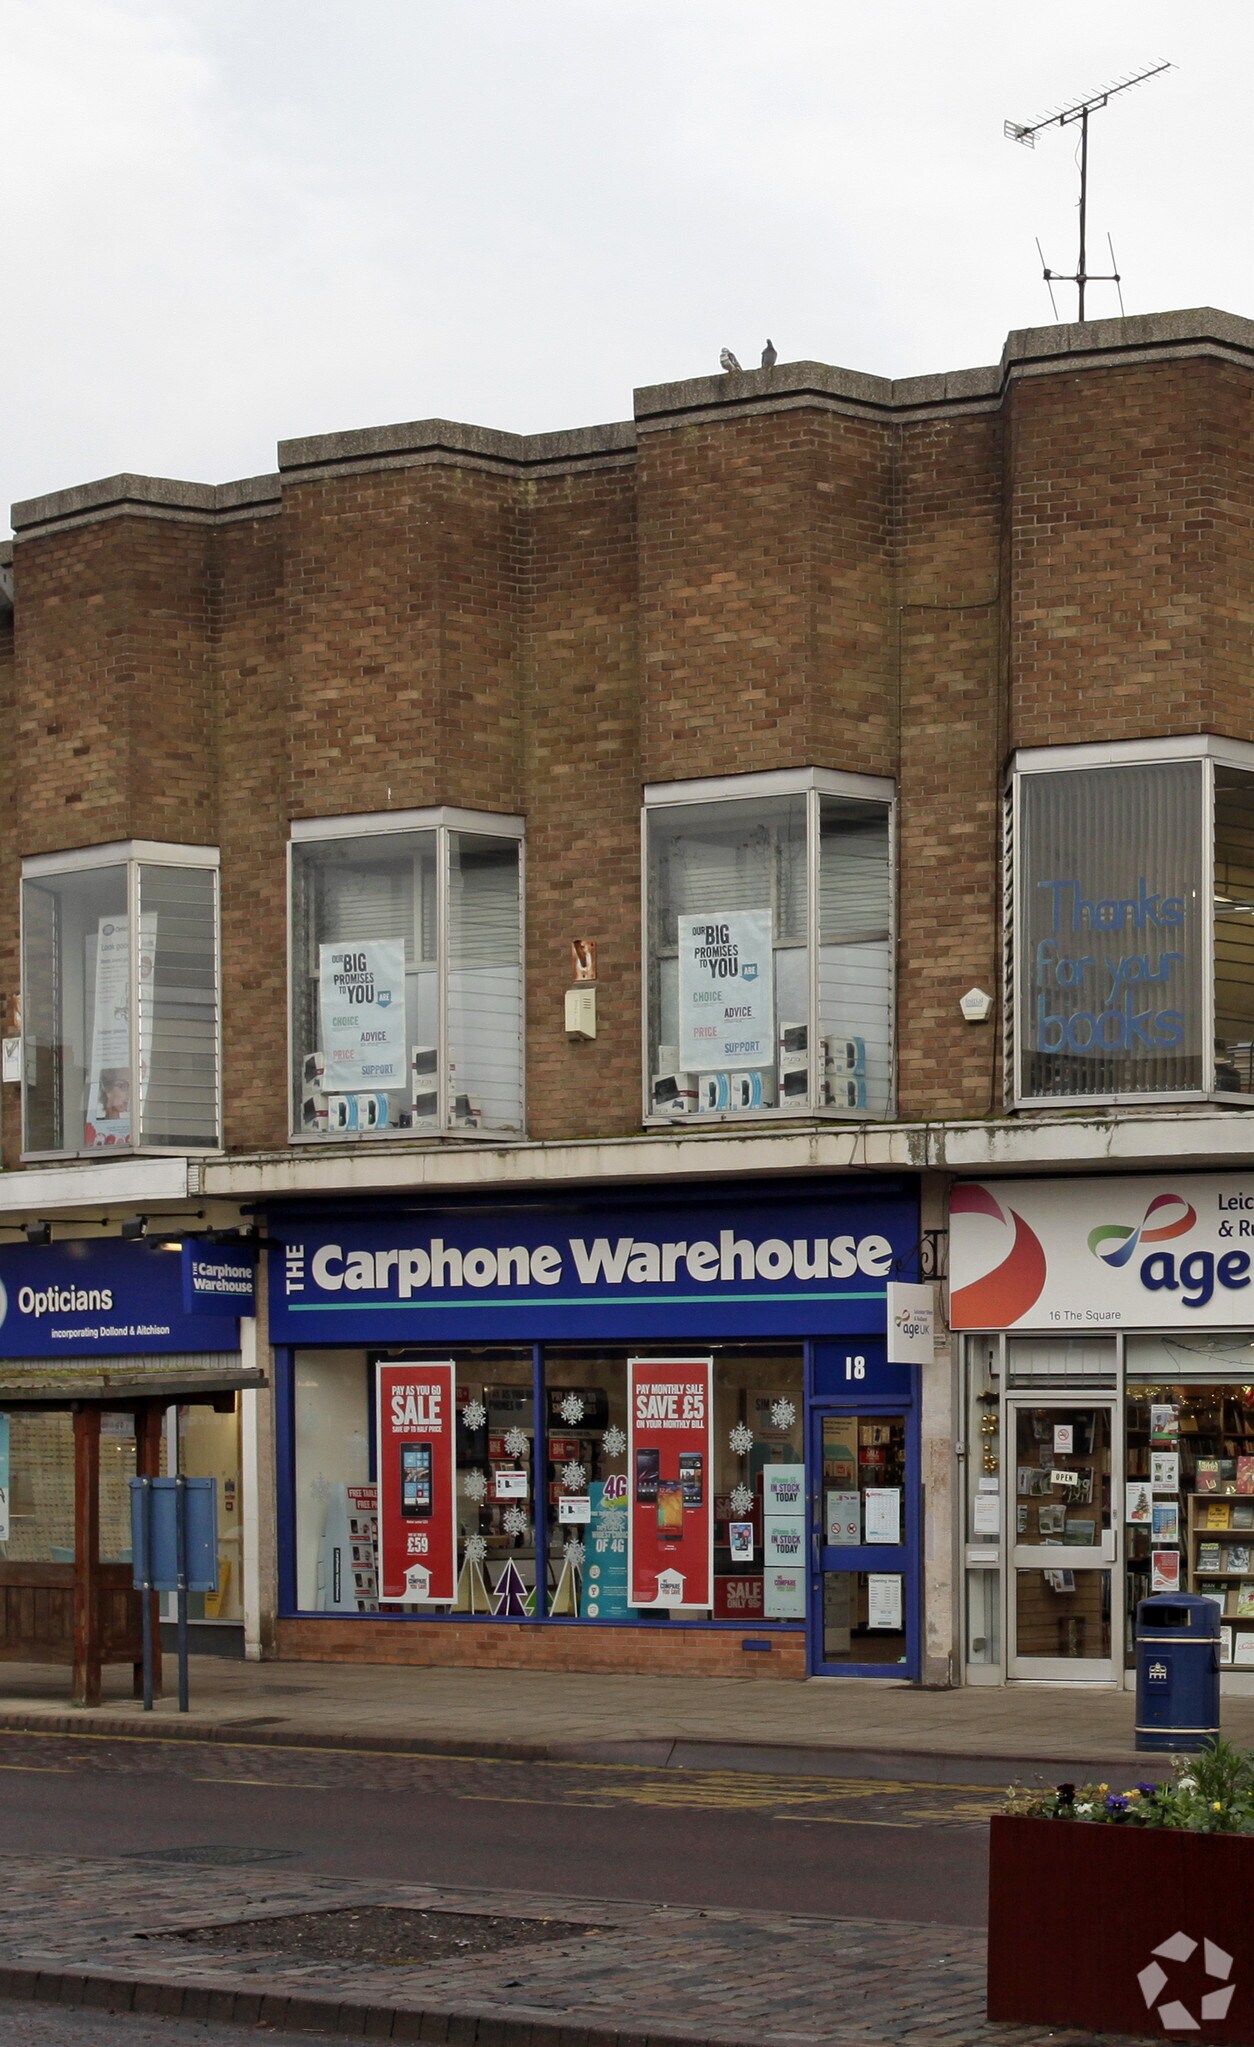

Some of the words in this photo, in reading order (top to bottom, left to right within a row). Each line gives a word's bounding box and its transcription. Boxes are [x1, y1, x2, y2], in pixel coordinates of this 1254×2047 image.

[1037, 877, 1185, 933] Thanks
[692, 926, 706, 936] OUR
[706, 924, 730, 945] BIG
[694, 944, 739, 959] PROMISES
[344, 953, 367, 972] BIG
[699, 959, 708, 968] TO
[708, 957, 739, 978] YOU
[334, 972, 375, 985] PROMISES
[1037, 938, 1097, 987] for
[1105, 951, 1185, 1006] your
[339, 986, 347, 994] TO
[347, 985, 375, 1004] YOU
[692, 991, 723, 1002] CHOICE
[724, 1006, 752, 1018] ADVICE
[332, 1015, 360, 1026] CHOICE
[1037, 989, 1185, 1054] books
[360, 1030, 387, 1042] ADVICE
[693, 1026, 718, 1038] PRICE
[724, 1041, 760, 1053] SUPPORT
[332, 1049, 355, 1060] PRICE
[361, 1064, 394, 1075] SUPPORT
[1218, 1220, 1234, 1237] &
[198, 1262, 253, 1279] Carphone
[286, 1244, 305, 1295] THE
[311, 1238, 563, 1299] Carphone
[568, 1229, 893, 1284] Warehouse
[193, 1278, 253, 1292] Warehouse
[1140, 1249, 1252, 1308] age
[18, 1284, 113, 1318] Opticians
[1049, 1311, 1061, 1321] 16
[1063, 1310, 1083, 1321] The
[1085, 1310, 1122, 1322] Square
[51, 1327, 99, 1340] incorporating
[100, 1326, 128, 1337] Dollond
[129, 1326, 136, 1336] &
[136, 1324, 170, 1336] Aitchison
[846, 1356, 866, 1381] 18
[392, 1385, 405, 1396] PAY
[405, 1385, 415, 1396] AS
[416, 1385, 430, 1396] YOU
[431, 1385, 442, 1396] GO
[636, 1384, 650, 1394] PAY
[651, 1384, 685, 1394] MONTHLY
[685, 1384, 704, 1395] SALE
[391, 1395, 443, 1425] SALE
[636, 1395, 679, 1419] SAVE
[682, 1395, 705, 1419] £5
[636, 1420, 645, 1428] ON
[646, 1420, 662, 1428] YOUR
[663, 1420, 690, 1428] MONTHLY
[691, 1420, 704, 1428] BILL
[1055, 1473, 1074, 1481] OPEN
[770, 1483, 778, 1492] IN
[778, 1483, 801, 1492] STOCK
[775, 1492, 798, 1502] TODAY
[407, 1537, 428, 1553] £59
[596, 1539, 609, 1553] OF
[611, 1539, 625, 1553] 4G
[771, 1535, 778, 1544] IN
[778, 1535, 801, 1544] STOCK
[776, 1544, 799, 1554] TODAY
[727, 1582, 761, 1599] SALE
[727, 1599, 746, 1609] ONLY
